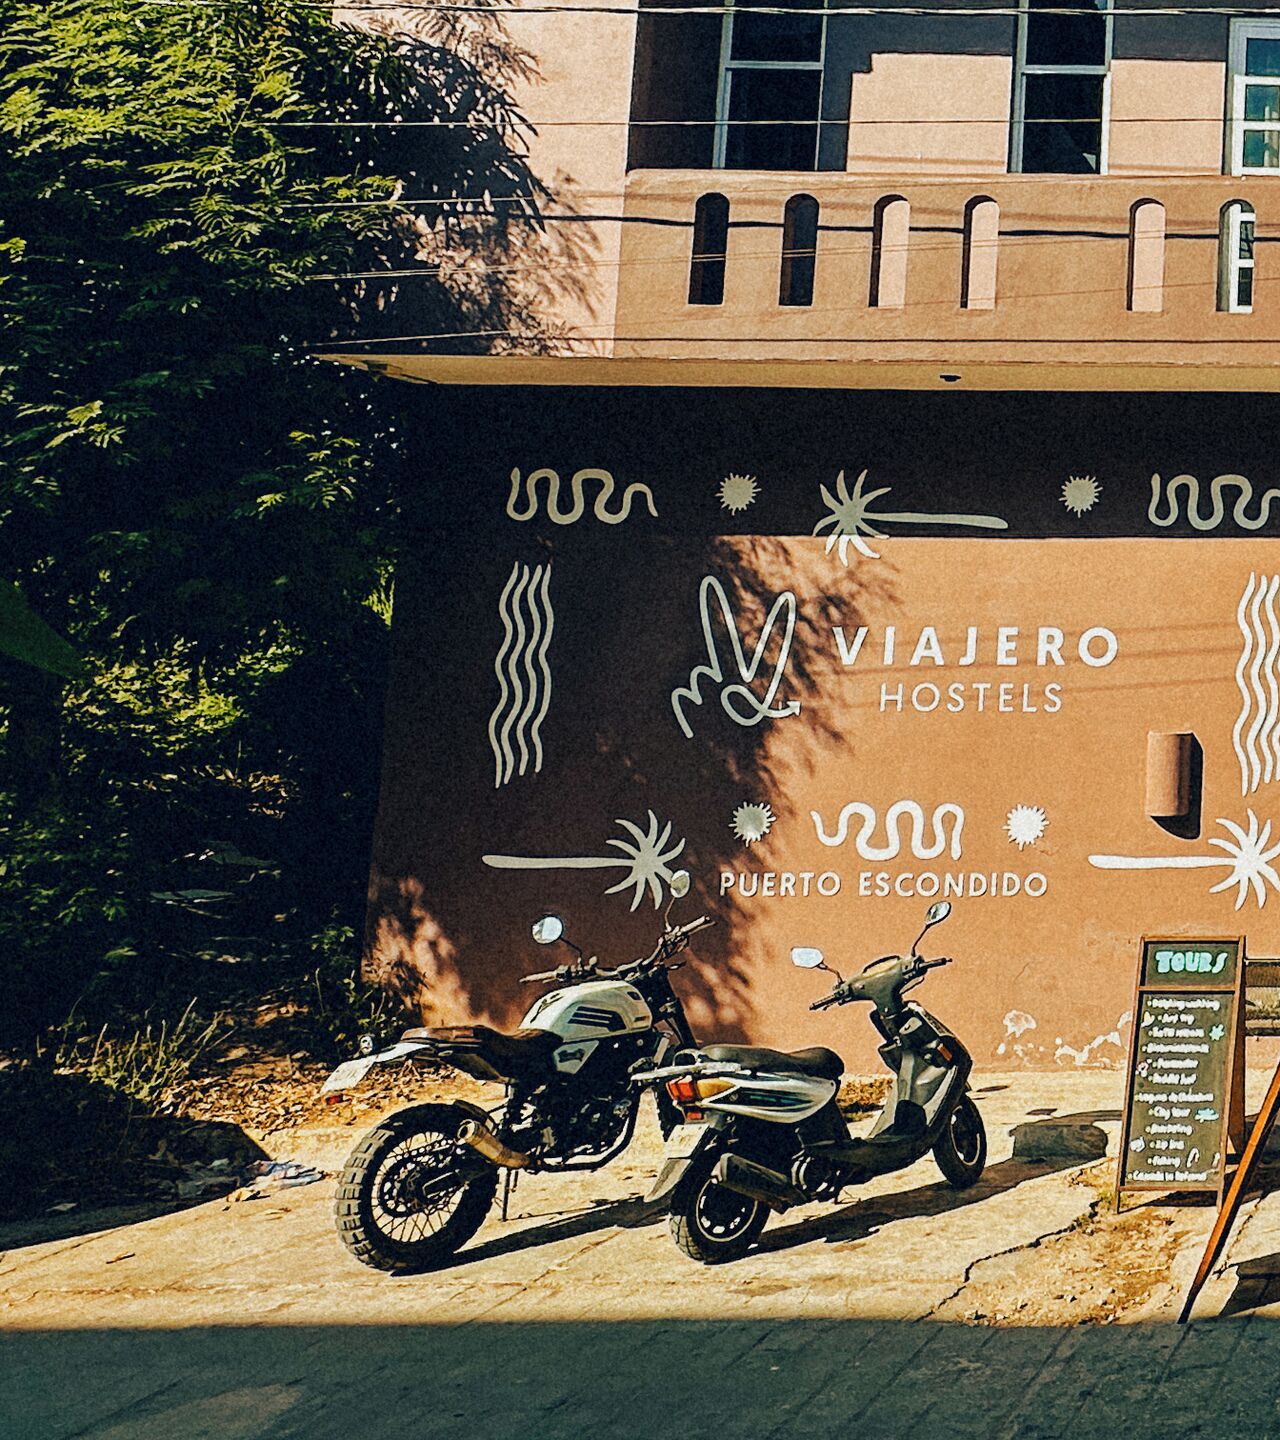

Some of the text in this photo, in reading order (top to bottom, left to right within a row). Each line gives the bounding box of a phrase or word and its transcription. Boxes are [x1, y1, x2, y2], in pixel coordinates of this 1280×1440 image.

[832, 625, 1118, 667] VIAJERO
[879, 682, 1063, 713] HOSTELS
[719, 871, 1048, 897] PUERTO ESCONDIDO
[1155, 951, 1228, 974] TOURS
